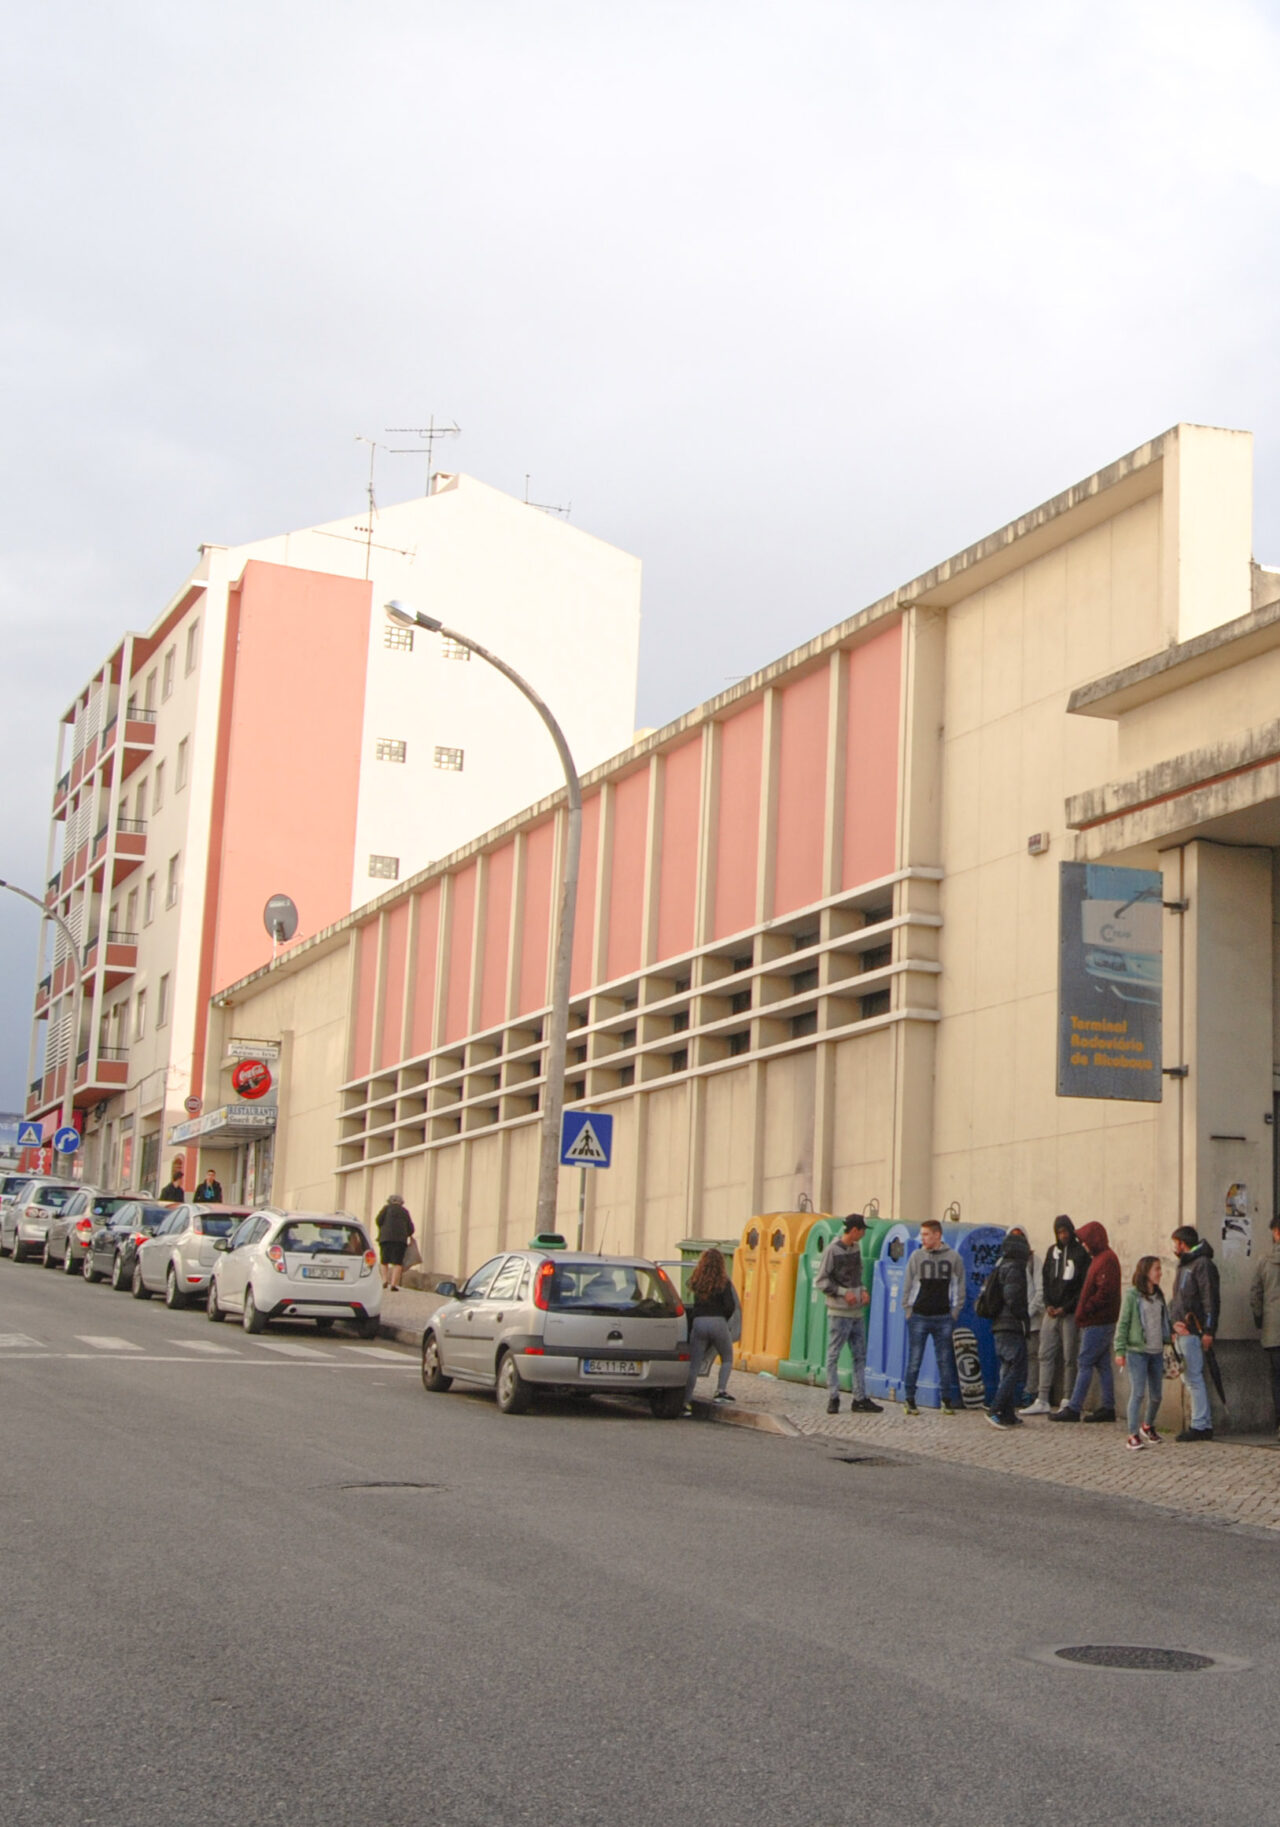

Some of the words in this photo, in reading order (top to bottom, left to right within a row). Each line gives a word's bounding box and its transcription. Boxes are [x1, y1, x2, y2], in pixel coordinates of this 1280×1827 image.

[1071, 1015, 1128, 1032] Terminal
[1070, 1052, 1088, 1065] de
[1094, 1053, 1152, 1071] Alcobaça
